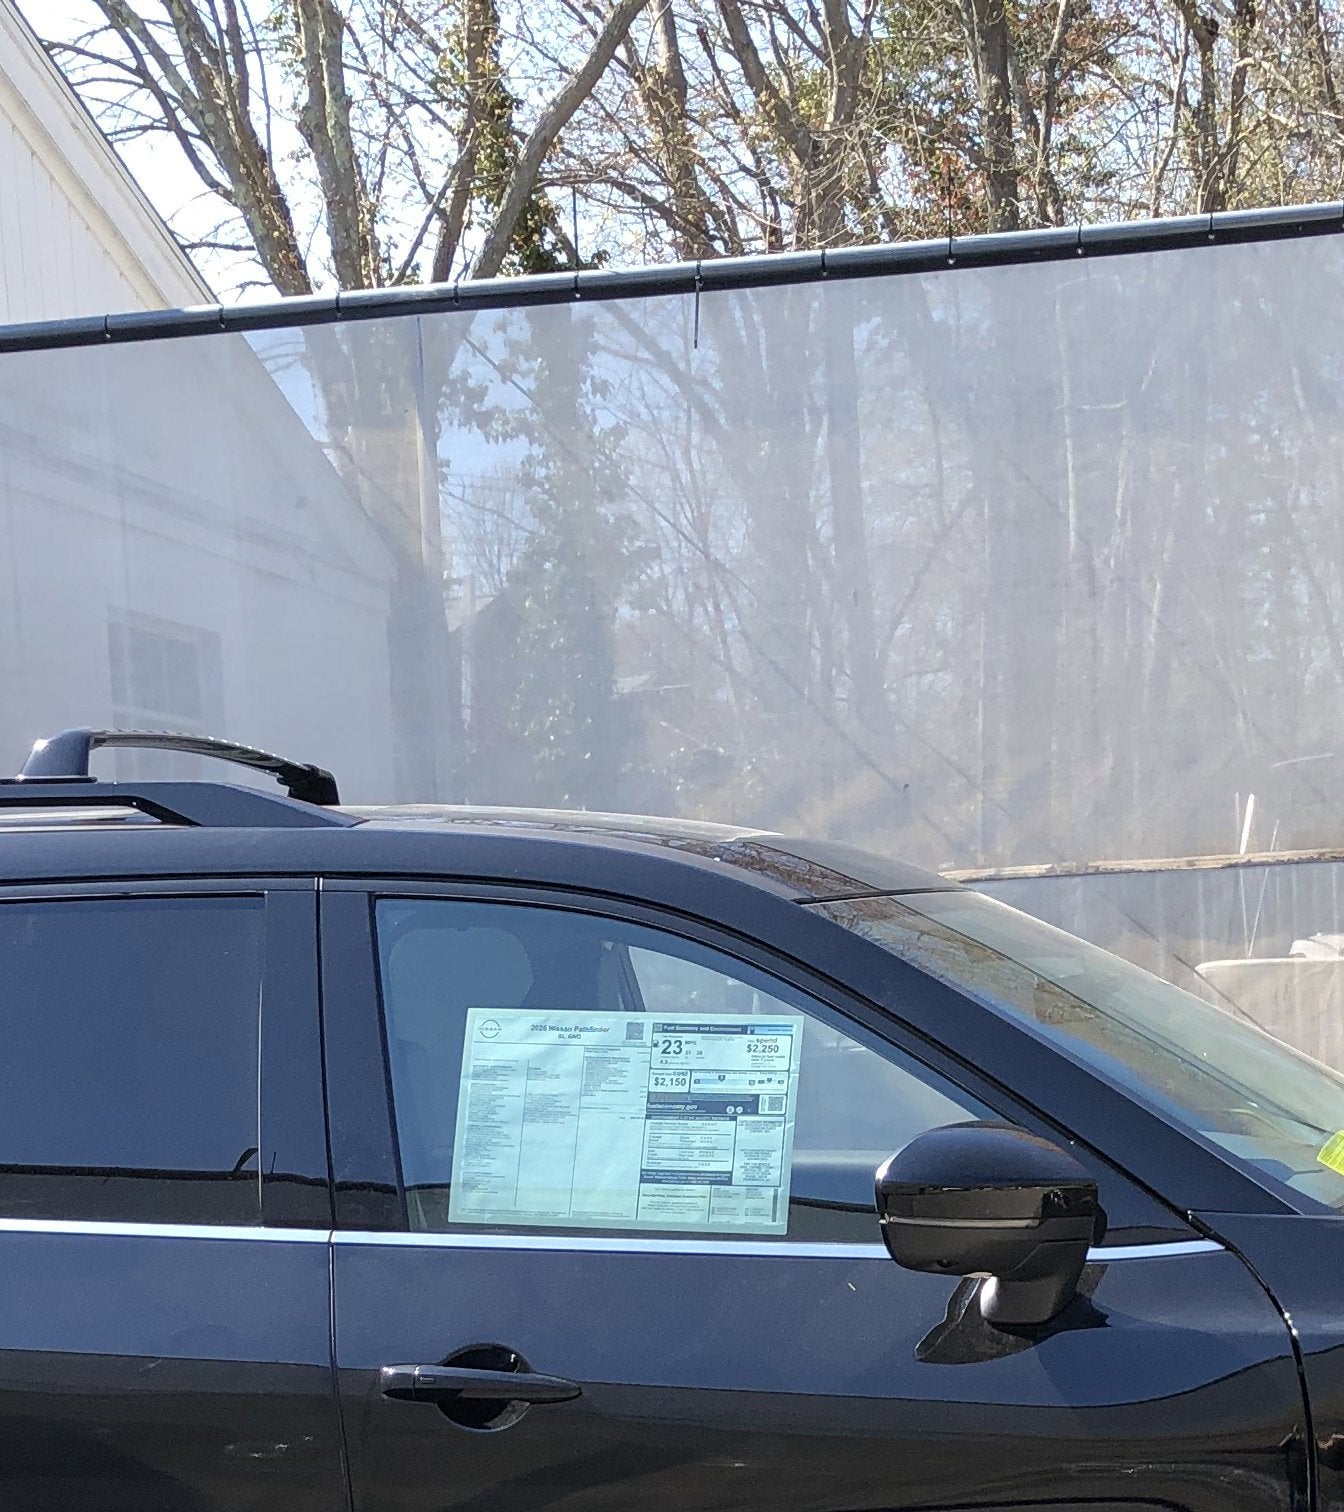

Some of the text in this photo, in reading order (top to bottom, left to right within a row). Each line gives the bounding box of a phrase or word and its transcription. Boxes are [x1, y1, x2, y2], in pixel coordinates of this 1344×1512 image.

[548, 1024, 573, 1032] Nissan
[661, 1039, 683, 1055] 23
[654, 1076, 687, 1087] $2,150
